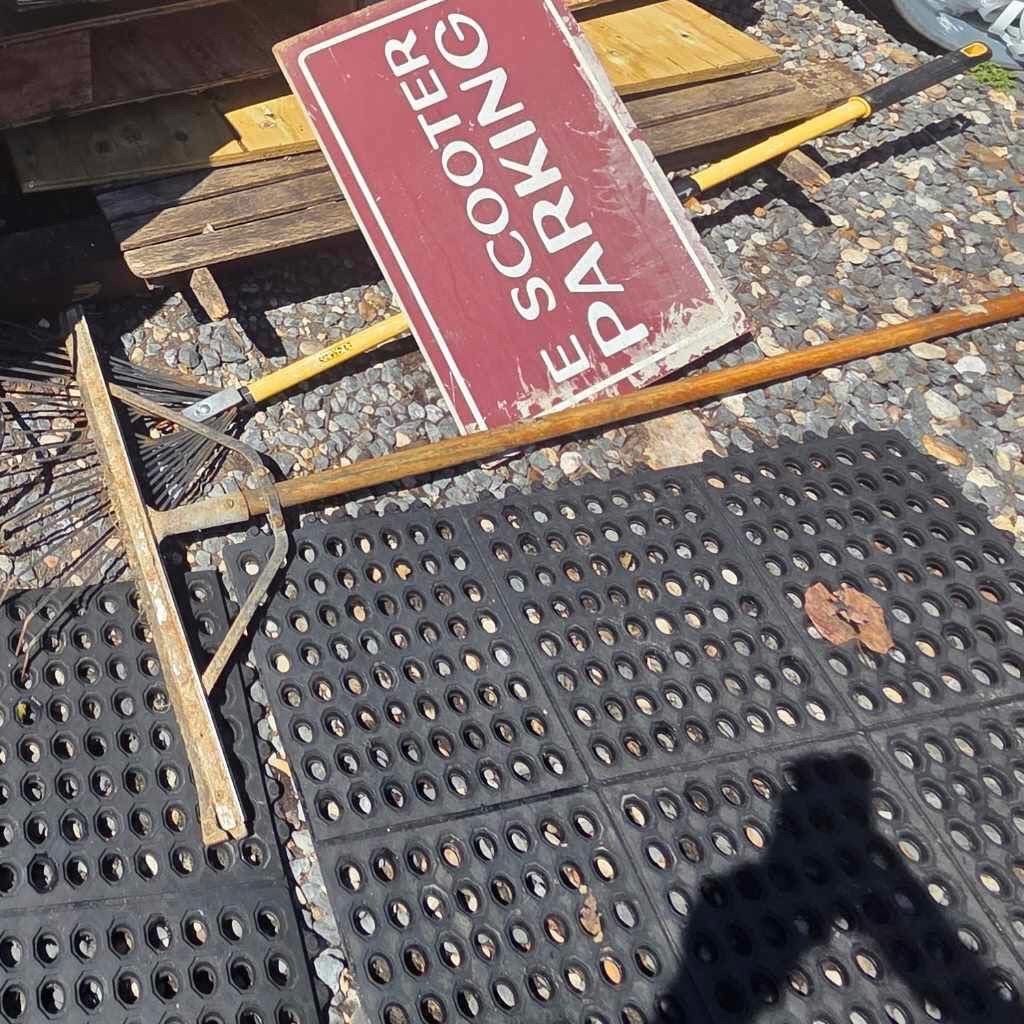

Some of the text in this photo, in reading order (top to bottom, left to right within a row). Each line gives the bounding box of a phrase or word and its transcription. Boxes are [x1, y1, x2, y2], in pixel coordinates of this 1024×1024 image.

[384, 28, 591, 384] E SCOOTER
[433, 11, 650, 358] PARKING
